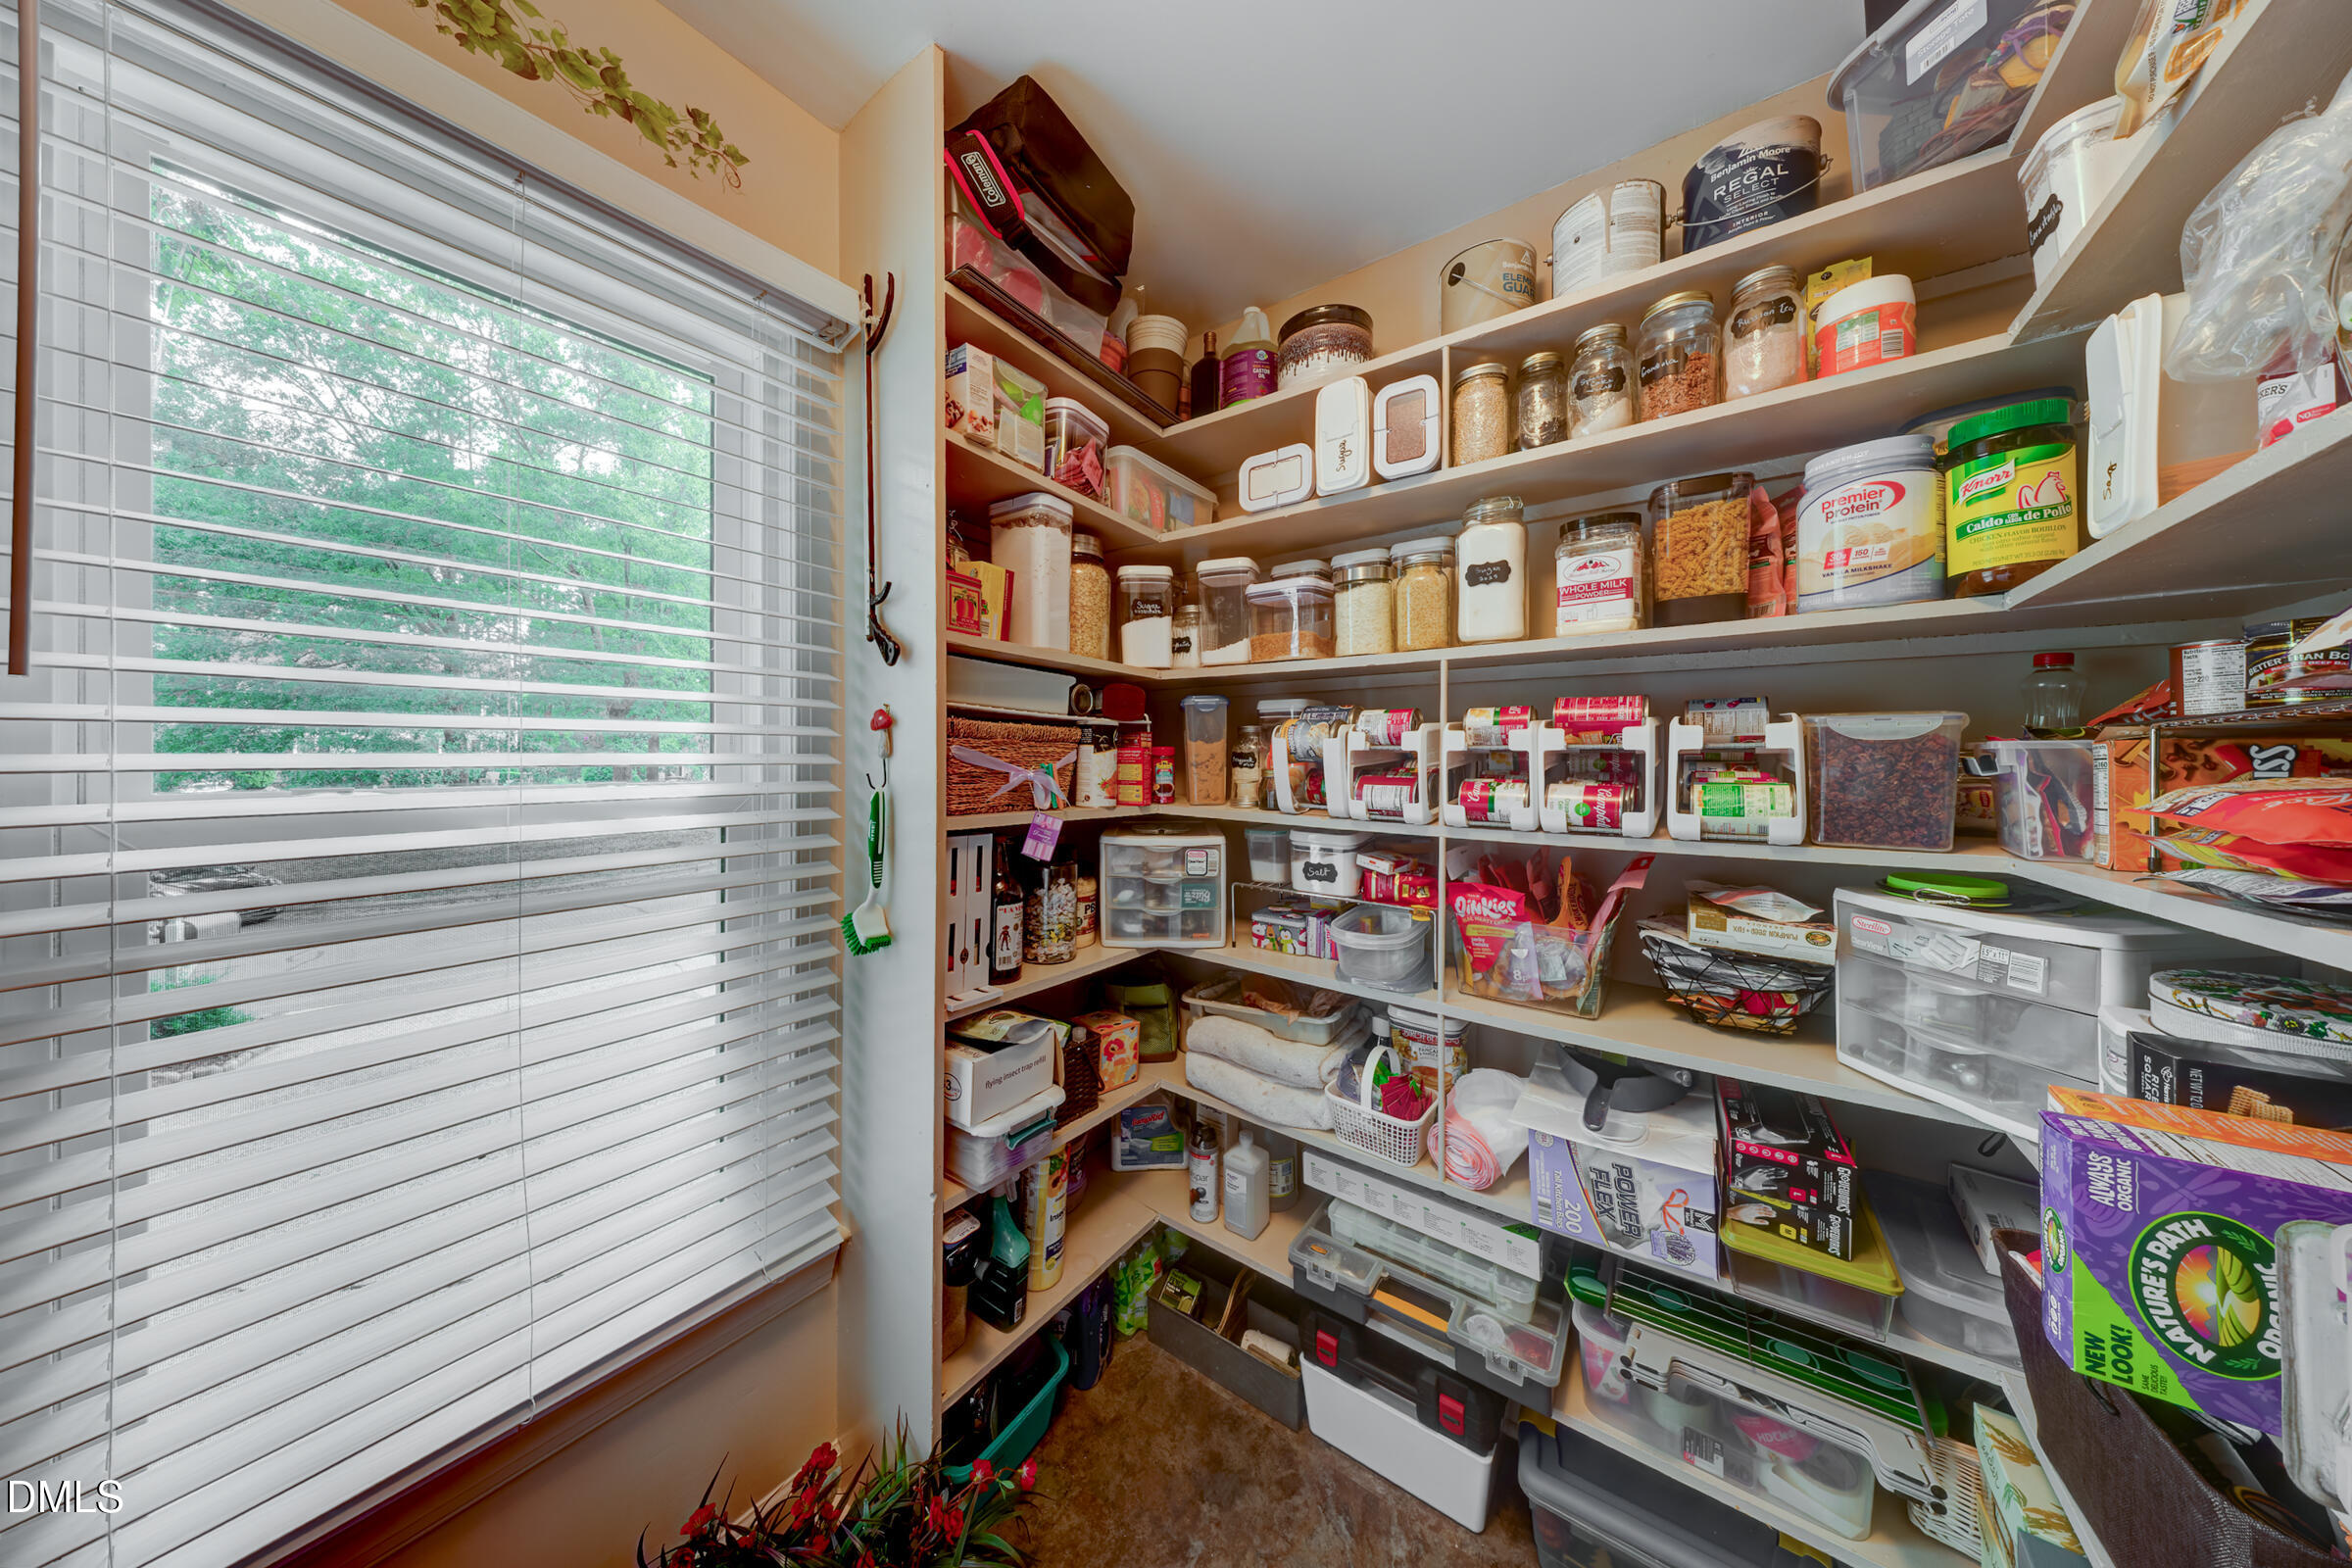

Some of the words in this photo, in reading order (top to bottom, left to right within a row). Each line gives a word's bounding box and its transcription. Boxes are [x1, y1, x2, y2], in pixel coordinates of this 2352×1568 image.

[1710, 154, 1756, 183] Benjamin
[1758, 146, 1791, 158] Moore
[972, 163, 999, 203] Coleman
[1713, 164, 1789, 201] REGAL
[1724, 177, 1780, 204] SELECT
[1733, 211, 1769, 227] INTERIOR
[1961, 469, 2012, 498] Knorr
[1821, 487, 1886, 514] premier
[1825, 499, 1880, 523] protein
[1966, 516, 2003, 533] Caldo
[2024, 511, 2040, 521] de
[2042, 504, 2072, 518] Pollo
[1854, 549, 1869, 558] 150
[1822, 566, 1849, 578] VANLA
[1850, 564, 1893, 574] MILKSHAKE
[1559, 583, 1598, 597] WHOLE
[1599, 578, 1627, 590] MILK
[1575, 590, 1610, 600] POWDER
[2248, 658, 2282, 677] BETTER
[2249, 744, 2297, 778] ISS
[1596, 787, 1613, 829] Campbell
[1307, 867, 1331, 876] Salt
[1455, 893, 1518, 920] Oinkies
[1768, 930, 1798, 942] PUMPKIN
[1856, 917, 1888, 933] Sterilite
[1851, 936, 1885, 952] ClearView
[985, 1076, 1004, 1090] flying
[1003, 1067, 1021, 1081] insect
[1021, 1062, 1034, 1074] trap
[1033, 1054, 1047, 1067] refill
[2143, 1054, 2152, 1103] SQUAR
[2189, 1068, 2202, 1080] NET
[2151, 1074, 2160, 1103] RICE
[2189, 1081, 2202, 1093] WT
[1553, 1170, 1562, 1182] Tall
[2086, 1151, 2115, 1207] ALWAYS
[2117, 1157, 2133, 1212] ORGANIC
[1553, 1183, 1562, 1207] Kitchen
[1590, 1167, 1616, 1223] FLEX
[1612, 1162, 1642, 1239] POWER
[1554, 1208, 1563, 1229] Bags
[1564, 1199, 1583, 1234] 200
[2162, 1218, 2214, 1260] PATH
[2140, 1255, 2217, 1364] NATURE'S
[2084, 1330, 2107, 1376] NEW
[2111, 1324, 2134, 1386] LOOK!
[2141, 1372, 2150, 1392] SAME
[2150, 1364, 2159, 1394] DELICIOUS
